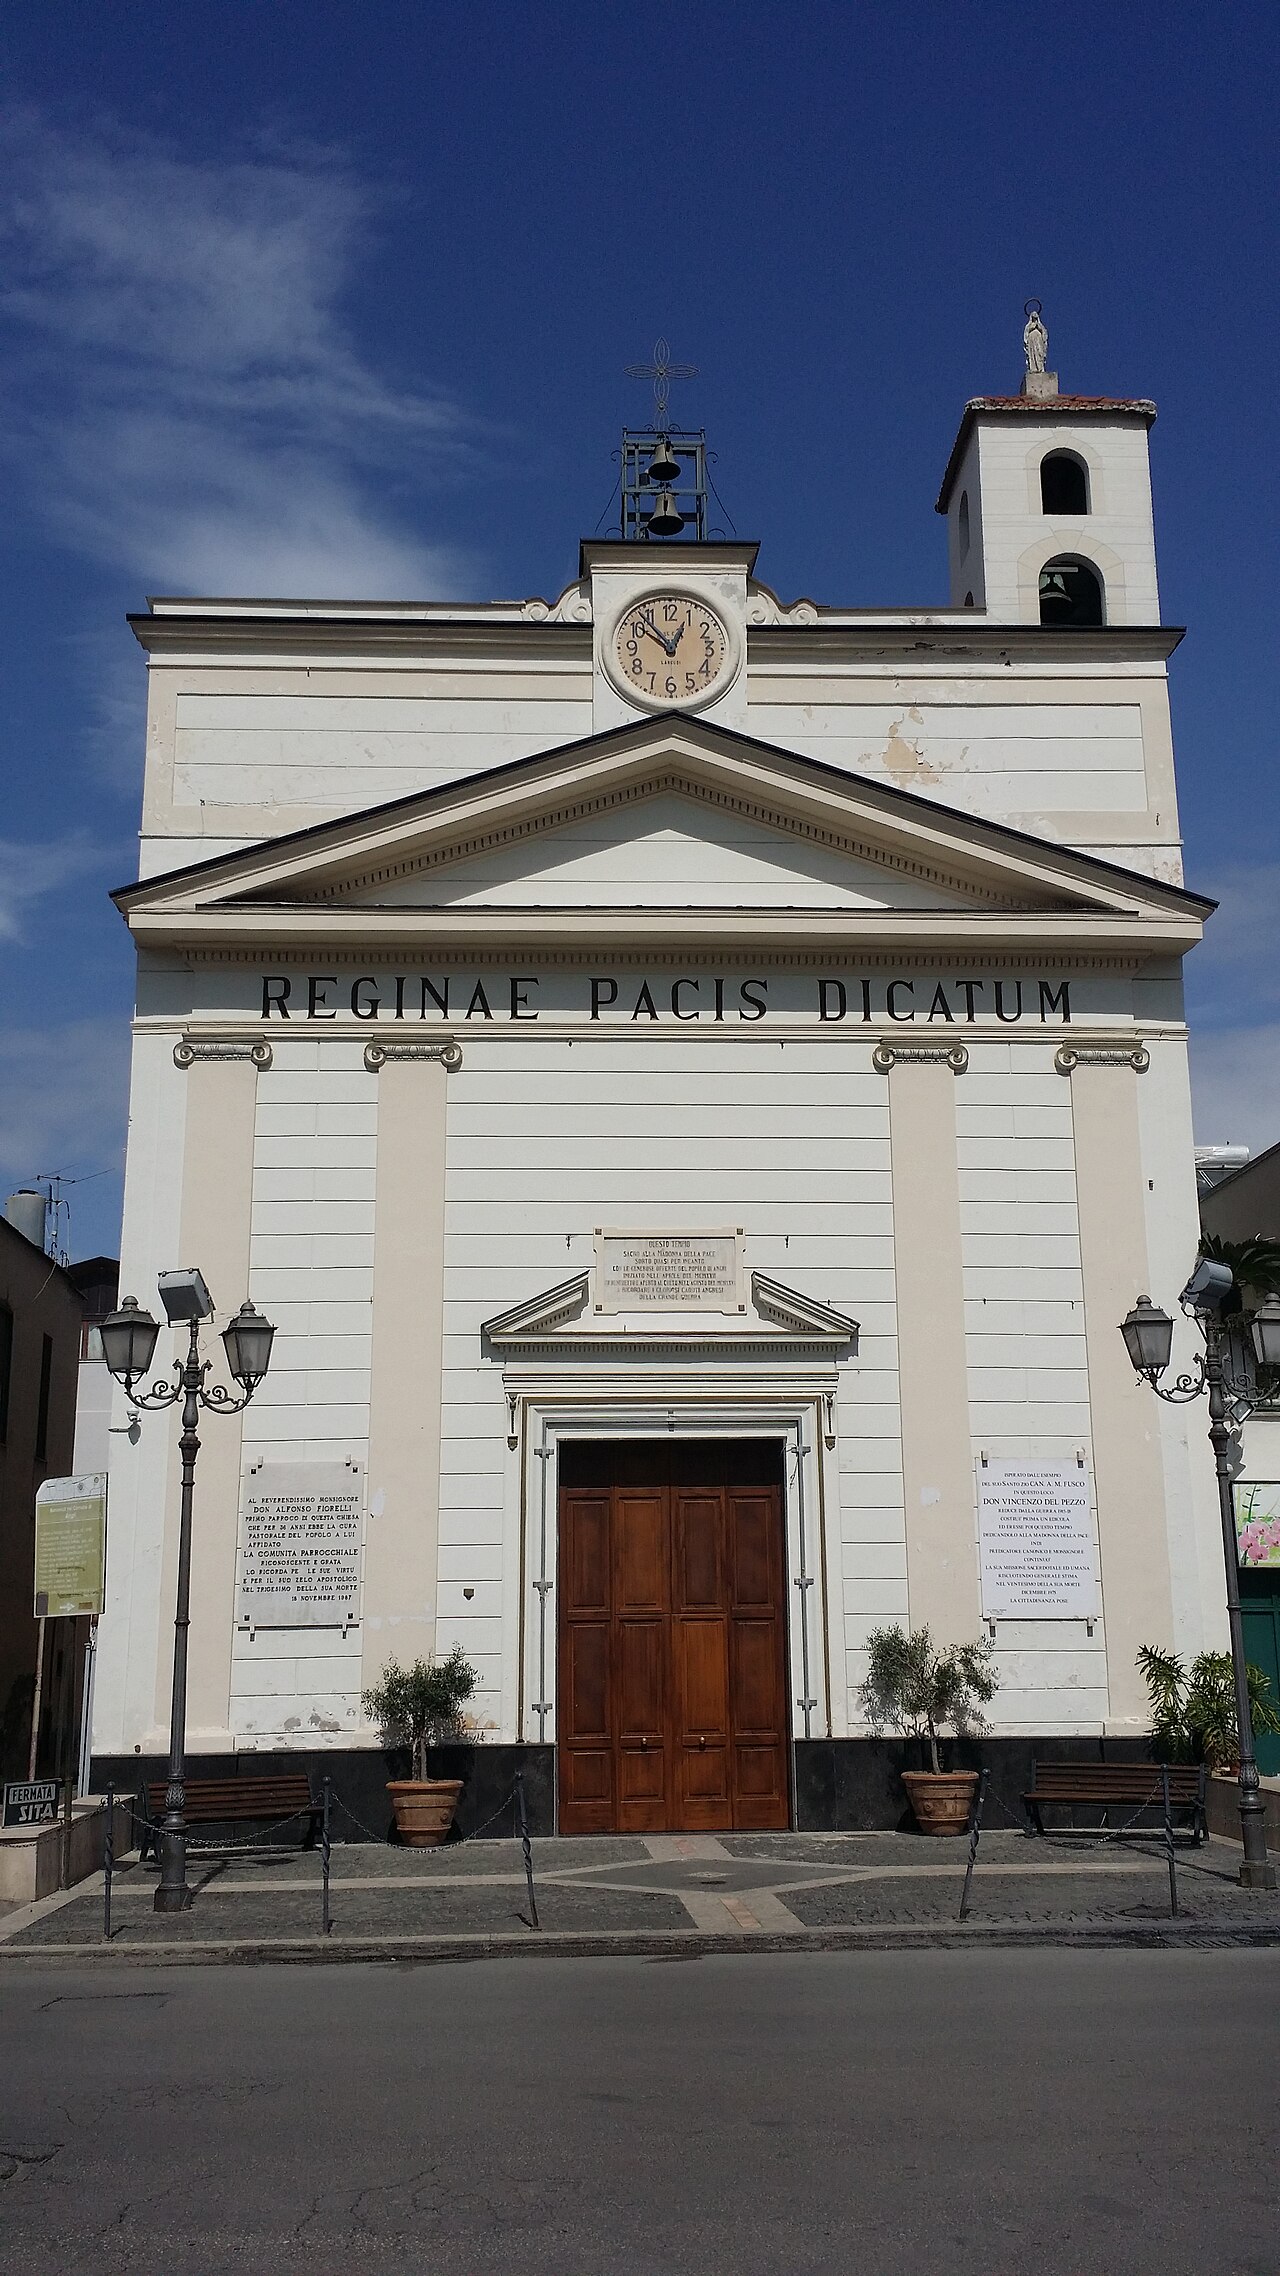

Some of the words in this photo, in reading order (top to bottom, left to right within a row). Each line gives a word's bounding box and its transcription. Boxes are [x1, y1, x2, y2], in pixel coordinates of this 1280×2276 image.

[662, 604, 678, 621] 12
[685, 609, 692, 626] 1
[630, 621, 646, 639] 10
[699, 622, 711, 640] 2
[626, 640, 638, 656] 9
[704, 640, 715, 658] 3
[631, 658, 643, 675] 8
[698, 659, 710, 677] 4
[646, 672, 657, 690] 7
[665, 676, 677, 694] 6
[685, 673, 696, 690] 5
[260, 976, 540, 1021] REGINAE
[588, 977, 769, 1022] PACIS
[817, 978, 1072, 1024] DICATUM
[12, 1786, 52, 1802] FERMATA
[19, 1803, 53, 1821] SITA
